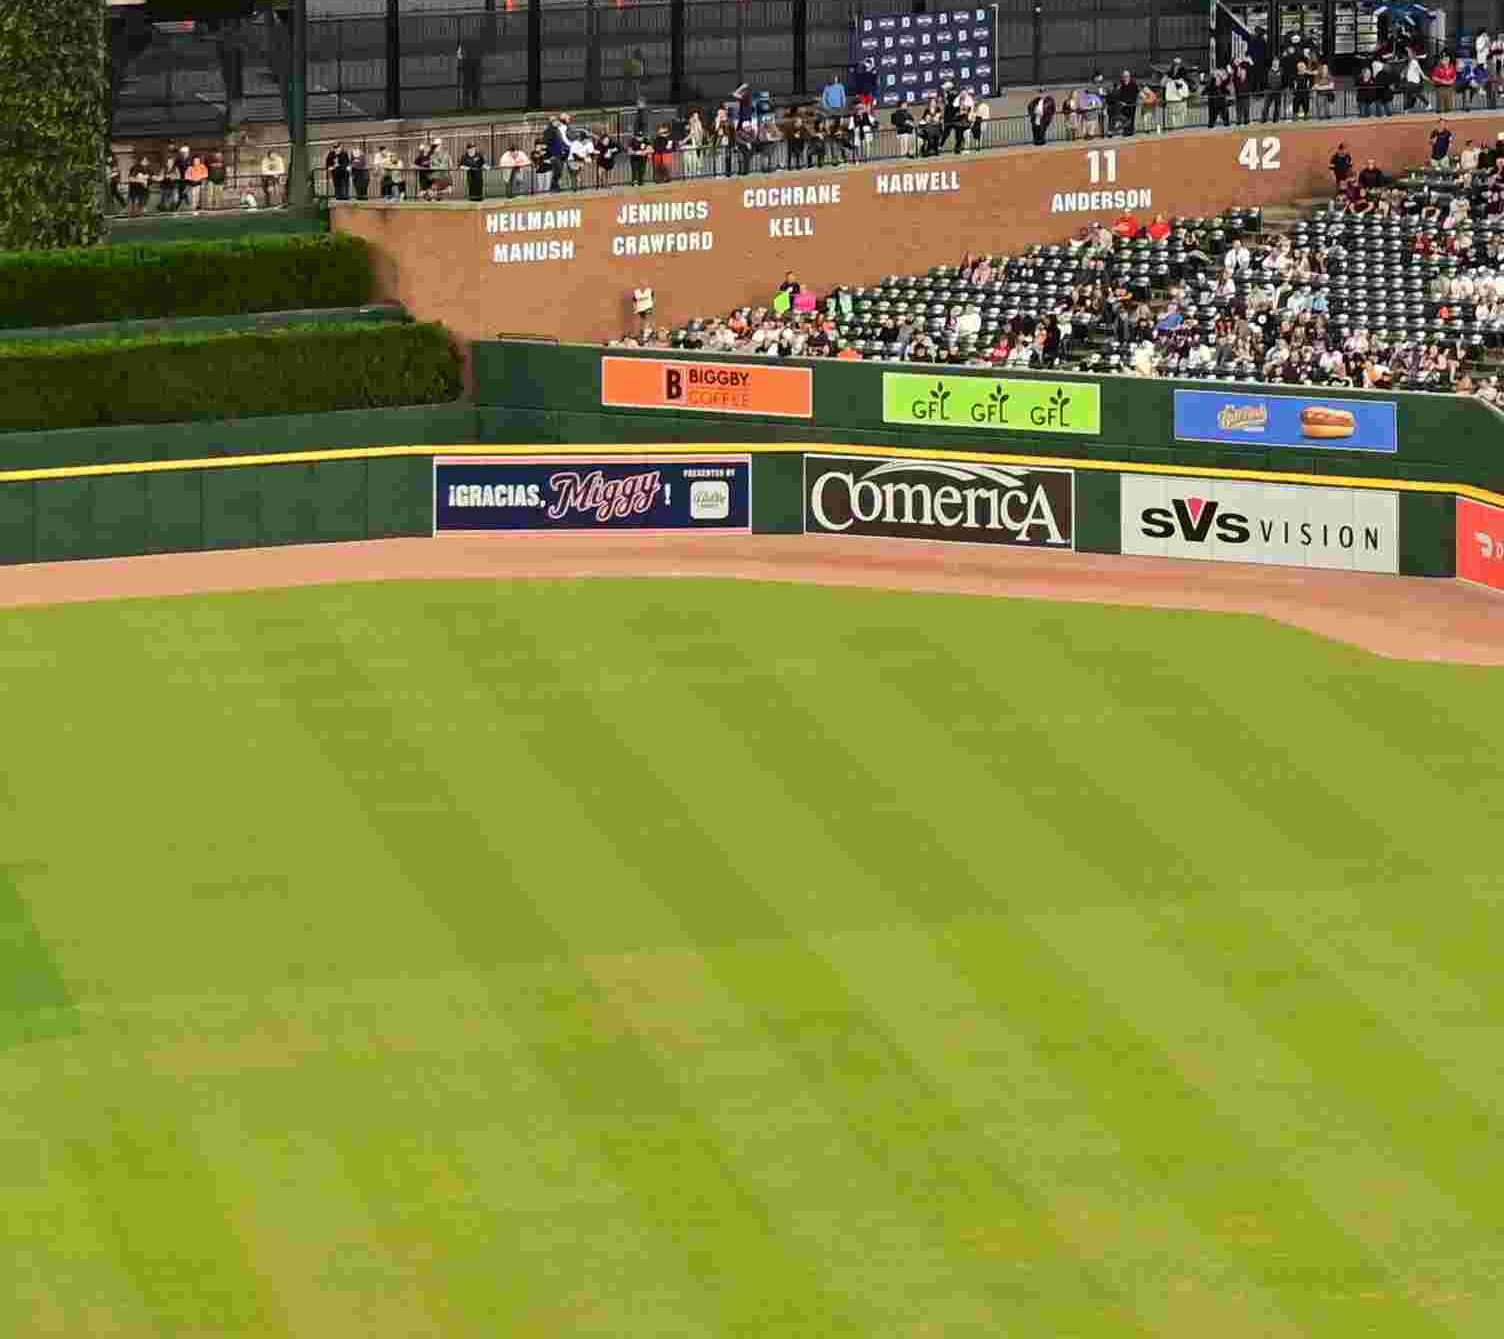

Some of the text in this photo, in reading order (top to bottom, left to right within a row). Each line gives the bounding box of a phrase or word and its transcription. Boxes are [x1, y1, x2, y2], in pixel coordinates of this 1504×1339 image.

[1087, 149, 1117, 184] 11
[1239, 136, 1281, 171] 42
[876, 170, 961, 194] HARWELL
[742, 183, 842, 210] COCHRANE
[1051, 187, 1152, 214] ANDERSON
[486, 208, 583, 235] HEILMANN
[616, 200, 709, 226] JENNINGS
[769, 217, 815, 239] KELL
[493, 241, 576, 264] MANUSH
[611, 229, 714, 256] CRAWFORD
[688, 368, 750, 386] BIGGBY
[912, 389, 1070, 426] GFL GFL GFL
[1260, 519, 1380, 551] VISION
